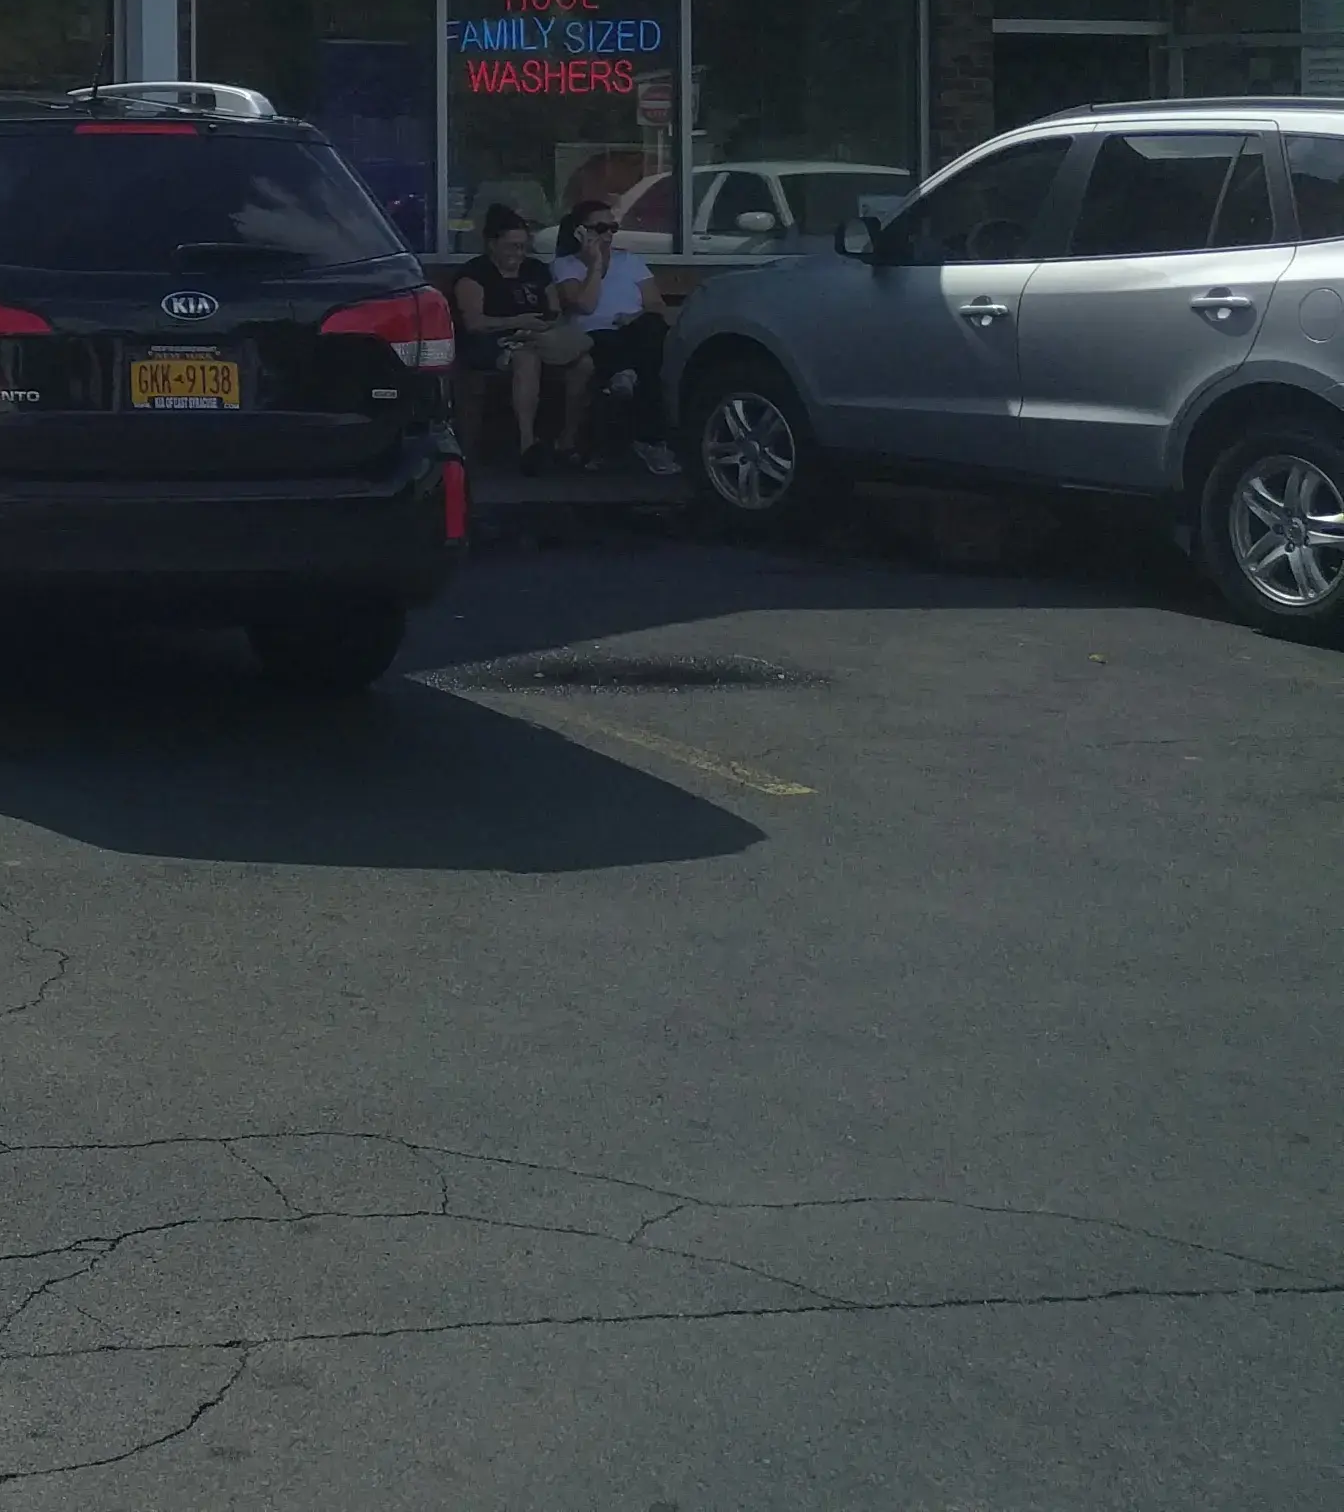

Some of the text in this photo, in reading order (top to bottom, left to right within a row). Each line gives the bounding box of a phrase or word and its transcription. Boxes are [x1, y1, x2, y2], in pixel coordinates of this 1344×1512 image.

[563, 19, 662, 54] SIZED
[466, 58, 634, 95] WASHERS
[171, 297, 212, 314] KIA
